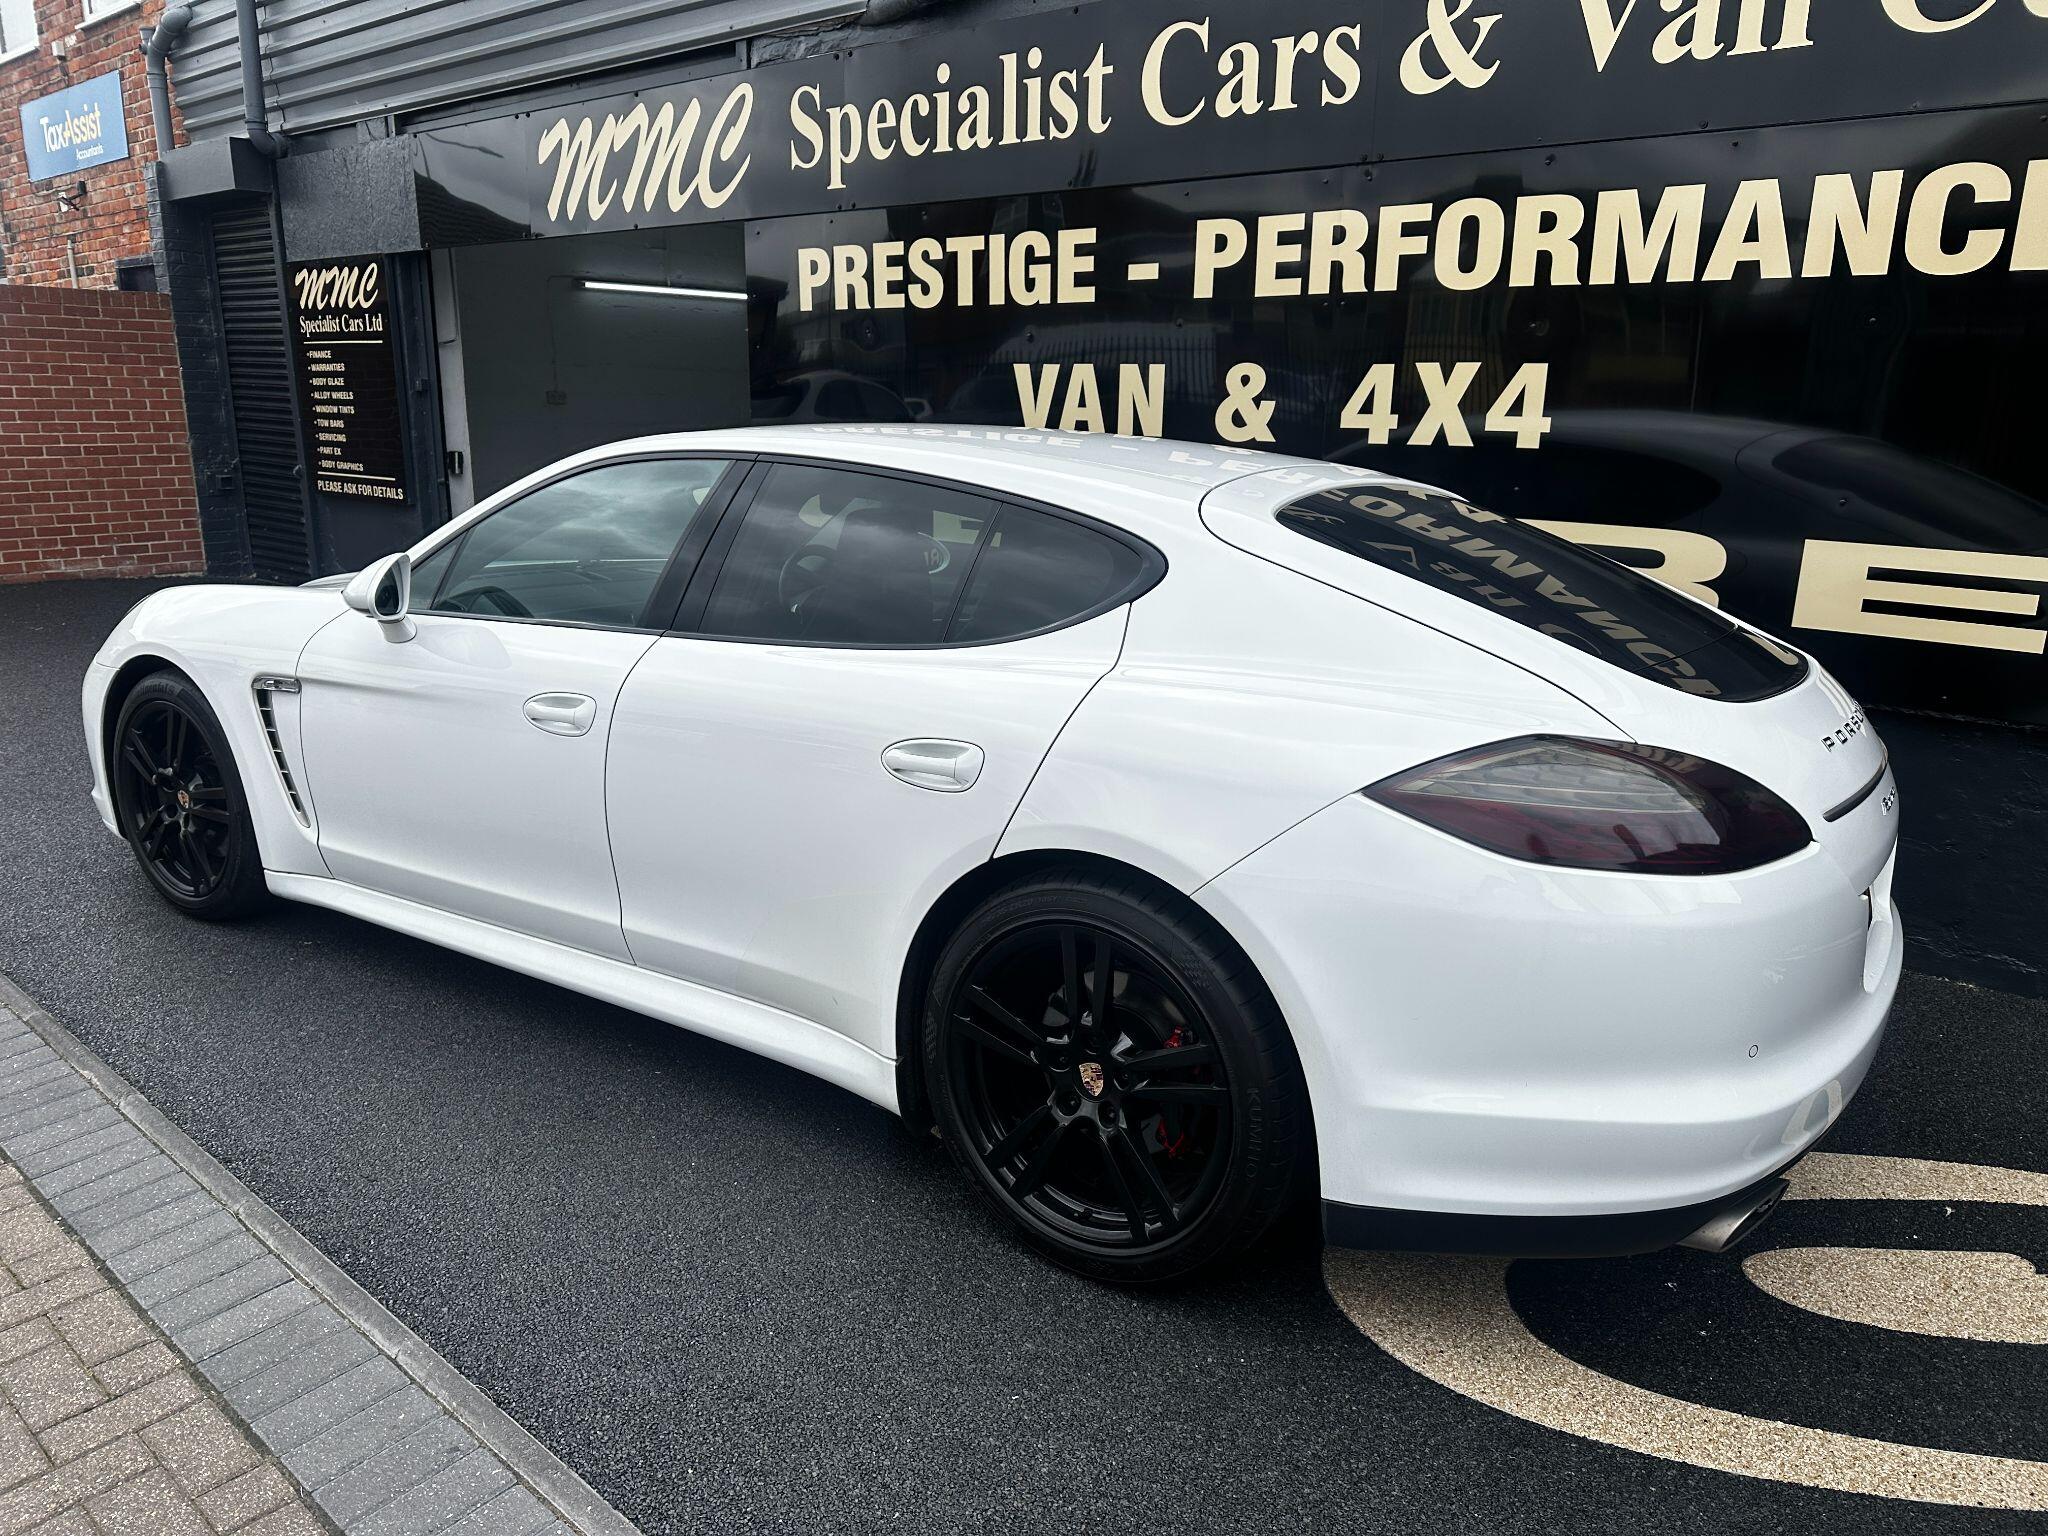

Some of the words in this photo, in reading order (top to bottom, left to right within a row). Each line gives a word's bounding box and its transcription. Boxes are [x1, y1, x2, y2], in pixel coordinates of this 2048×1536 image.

[538, 82, 754, 222] MMC
[790, 43, 1115, 189] Specialist
[1139, 16, 1363, 128] Cars
[1400, 0, 1502, 95] &
[76, 144, 104, 160] Accountants
[798, 227, 1097, 311] PRESTIGE
[295, 262, 379, 310] MMC
[300, 315, 341, 338] Specialist
[341, 313, 364, 332] Cars
[365, 313, 384, 332] Ltd
[309, 350, 332, 359] FINANCE
[311, 363, 345, 372] WARRANTIES
[312, 377, 327, 386] BODY
[327, 377, 345, 386] GLAZE
[314, 391, 331, 400] ALLOY
[331, 391, 354, 400] WHEELS
[315, 405, 338, 414] WINDOW
[339, 405, 355, 415] TINTS
[1013, 363, 1166, 437] VAN
[1215, 362, 1277, 442] &
[1340, 362, 1552, 449] 4X4
[317, 418, 329, 427] TOW
[330, 419, 345, 429] BARS
[318, 432, 347, 442] SERVICING
[320, 446, 334, 455] PART
[334, 447, 342, 456] EX
[321, 459, 336, 468] BODY
[336, 461, 364, 472] GRAPHICS
[317, 480, 343, 493] PLEASE
[343, 482, 358, 495] ASK
[358, 484, 373, 497] FOR
[373, 486, 404, 500] DETAILS
